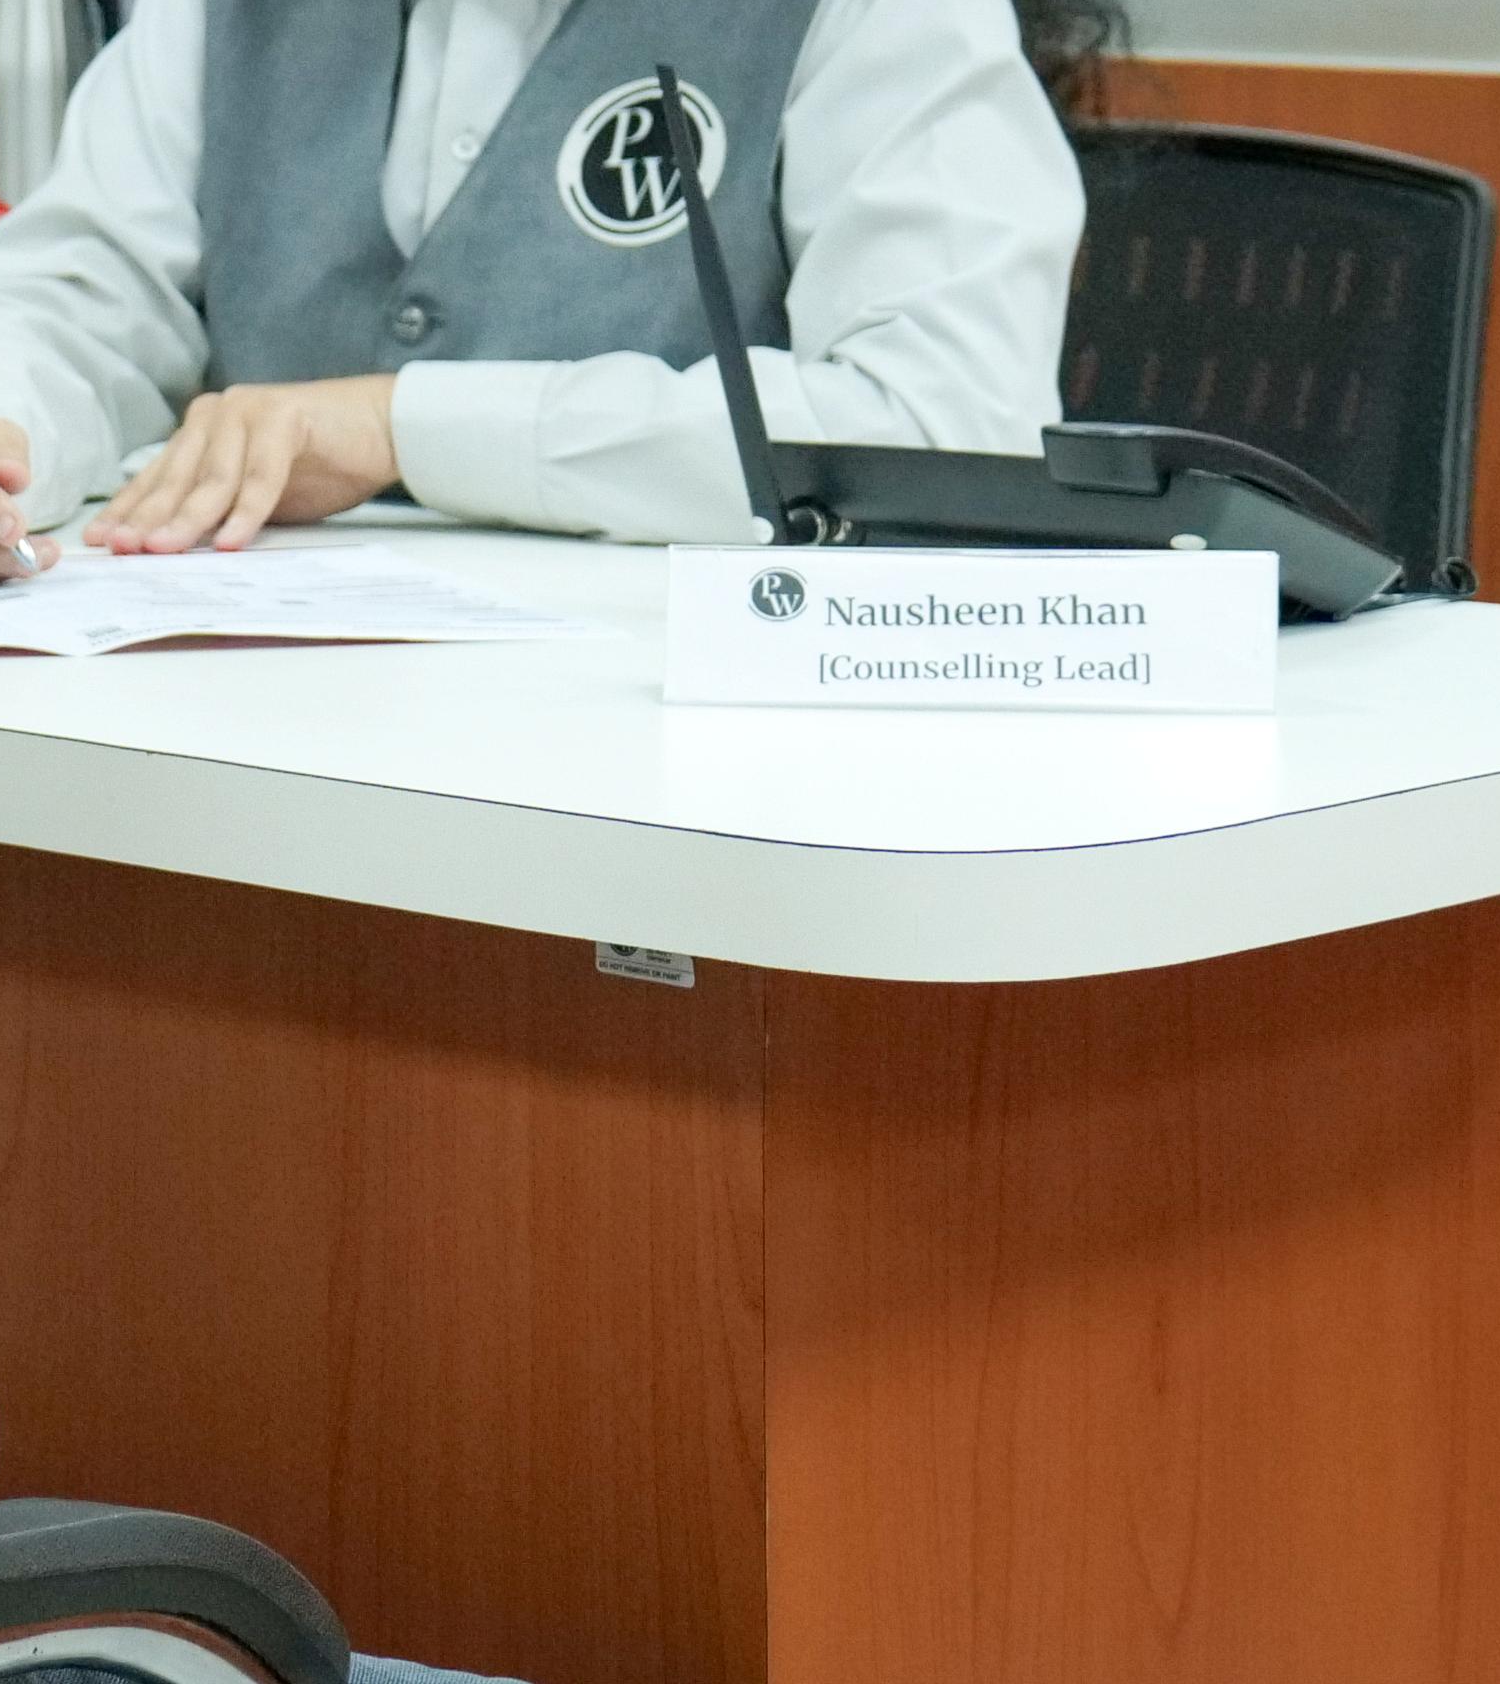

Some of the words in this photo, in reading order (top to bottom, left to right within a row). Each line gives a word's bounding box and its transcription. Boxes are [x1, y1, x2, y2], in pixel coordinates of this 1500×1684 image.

[824, 594, 1025, 627] Nausheen
[1039, 595, 1147, 626] Khan
[818, 652, 1044, 688] [Counselling
[1054, 652, 1152, 685] Lead]
